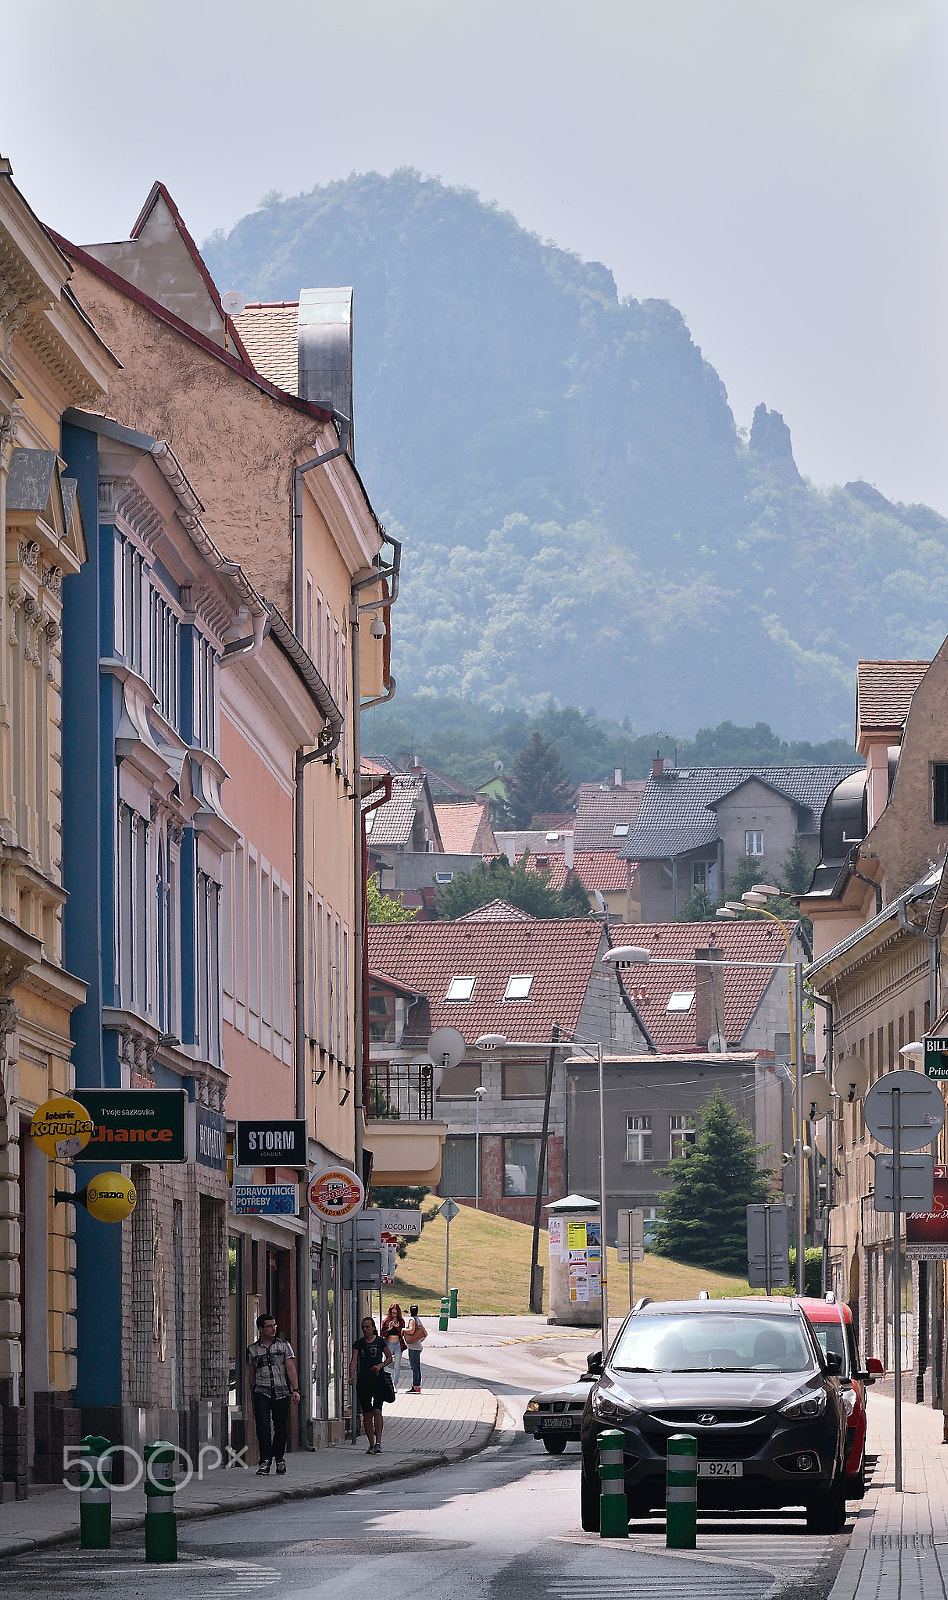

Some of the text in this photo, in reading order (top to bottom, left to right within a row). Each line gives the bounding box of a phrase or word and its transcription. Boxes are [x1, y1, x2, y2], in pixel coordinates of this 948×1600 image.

[45, 1110, 76, 1121] loterie
[100, 1108, 121, 1117] Tvoje
[30, 1120, 94, 1137] Korunka
[248, 1130, 295, 1150] STORM
[98, 1190, 125, 1200] sazka
[236, 1185, 295, 1196] ZDRAVOTNICKÉ
[236, 1196, 271, 1206] POTŘEBY
[384, 1223, 417, 1231] KOCOURA
[709, 1462, 737, 1475] 9241
